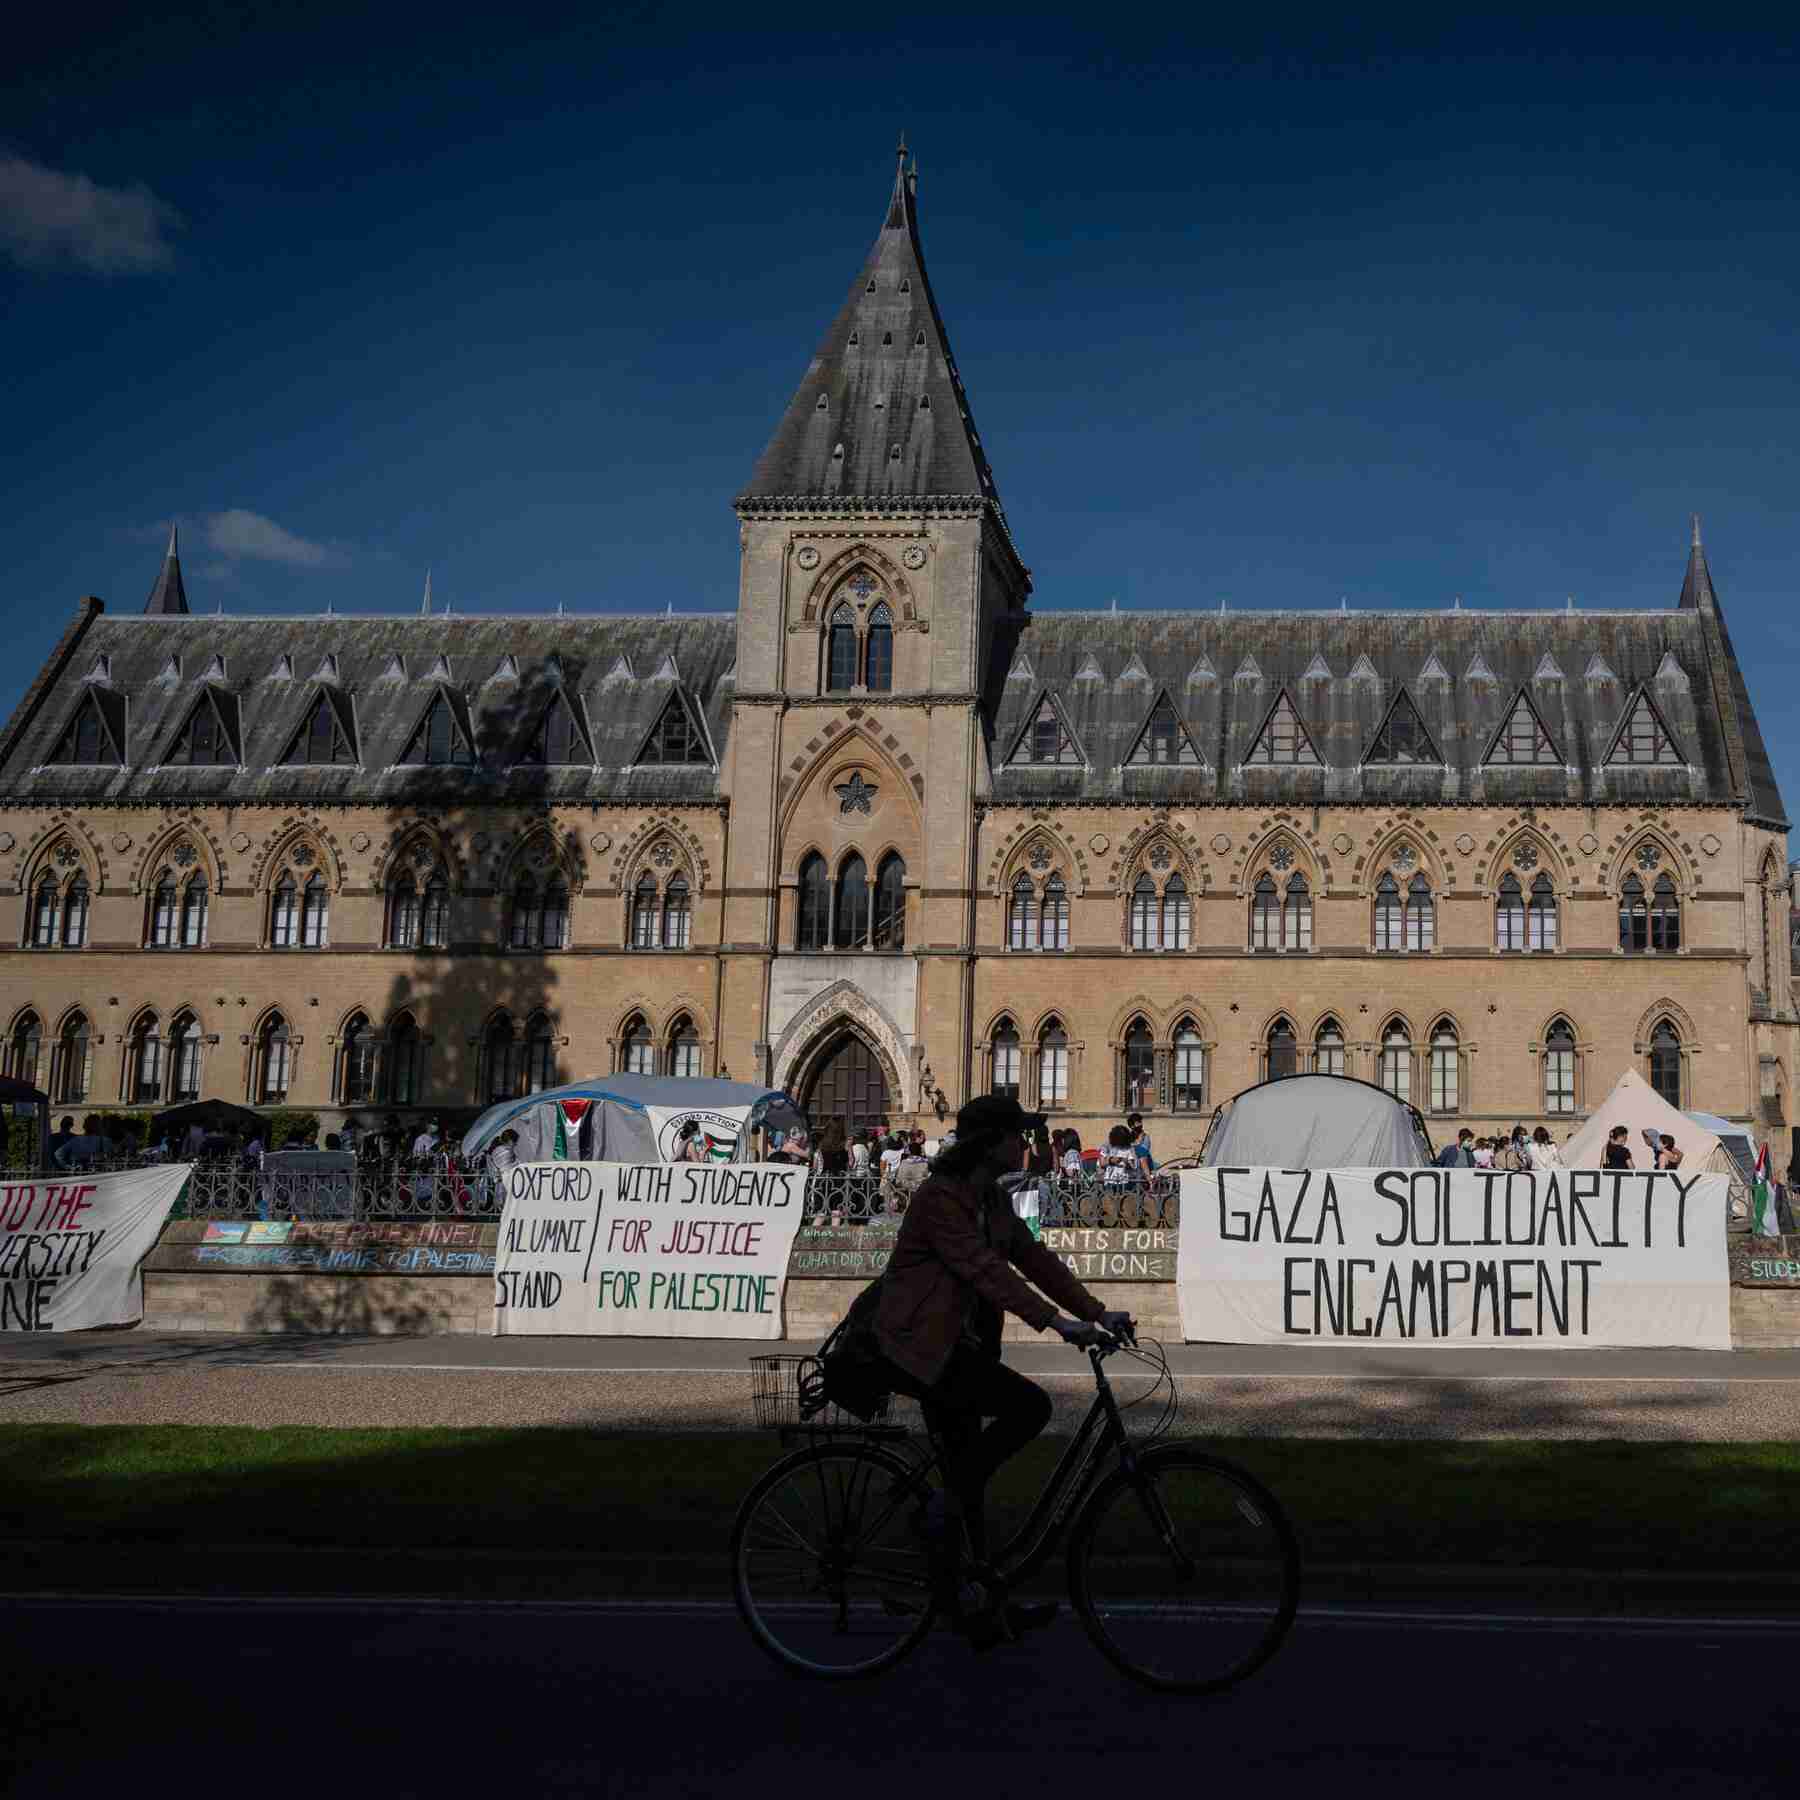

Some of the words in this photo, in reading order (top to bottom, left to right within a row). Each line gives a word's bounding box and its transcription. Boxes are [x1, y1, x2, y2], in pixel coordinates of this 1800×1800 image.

[704, 1115, 738, 1129] ACTION
[511, 1167, 592, 1201] OXFORD
[617, 1166, 672, 1203] WITH
[681, 1168, 794, 1207] STUDENTS
[34, 1185, 97, 1231] THE
[1217, 1168, 1345, 1244] GAZA
[1374, 1170, 1702, 1248] SOLIDARITY
[505, 1218, 586, 1253] ALUMNI
[607, 1218, 652, 1254] FOR
[660, 1220, 765, 1257] JUSTICE
[1122, 1230, 1166, 1250] FOR
[1057, 1254, 1148, 1275] ATION
[2, 1280, 57, 1330] NE
[495, 1270, 562, 1309] STAND
[598, 1270, 641, 1309] FOR
[649, 1272, 777, 1314] PALESTINE
[1283, 1257, 1602, 1338] ENCAMPMENT
